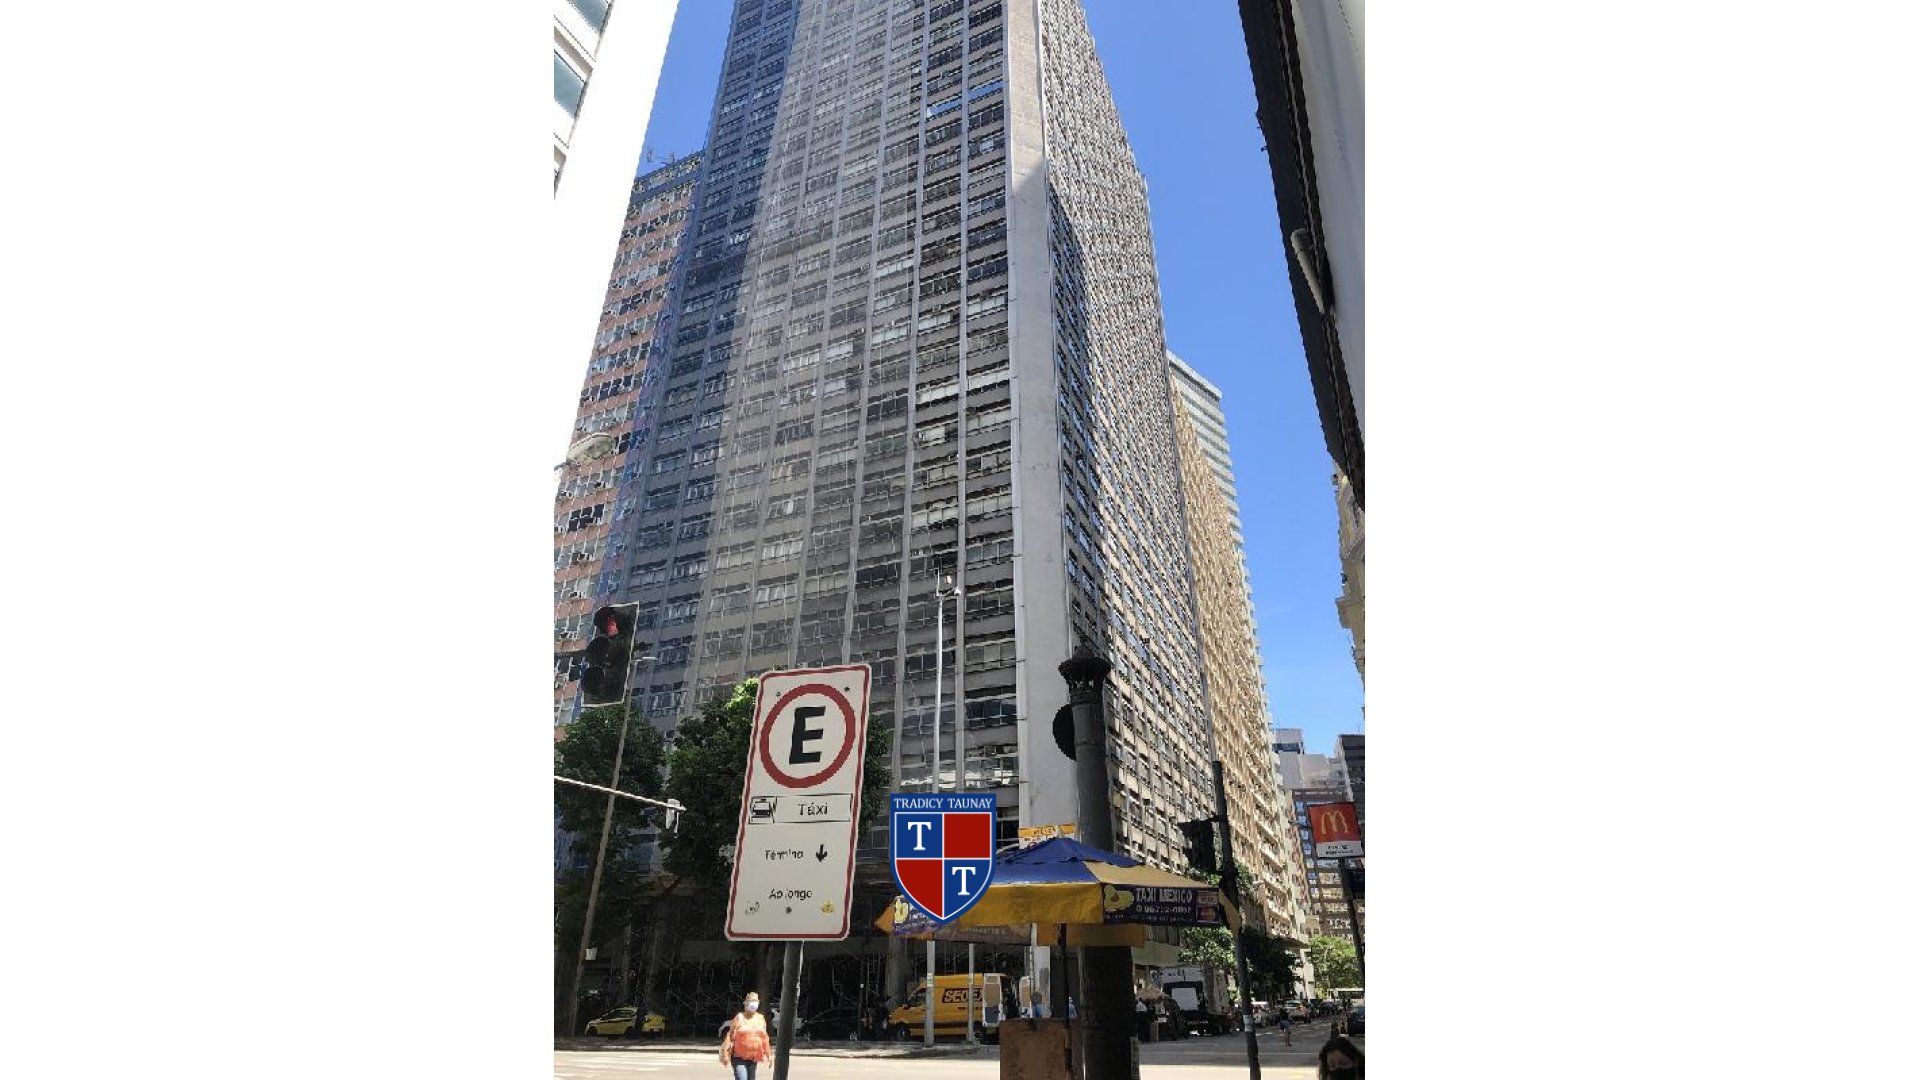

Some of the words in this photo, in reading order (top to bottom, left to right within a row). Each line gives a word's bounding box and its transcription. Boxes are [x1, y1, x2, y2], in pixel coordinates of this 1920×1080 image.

[789, 706, 826, 765] E
[798, 802, 828, 816] Táxi
[1136, 887, 1156, 903] TAXI
